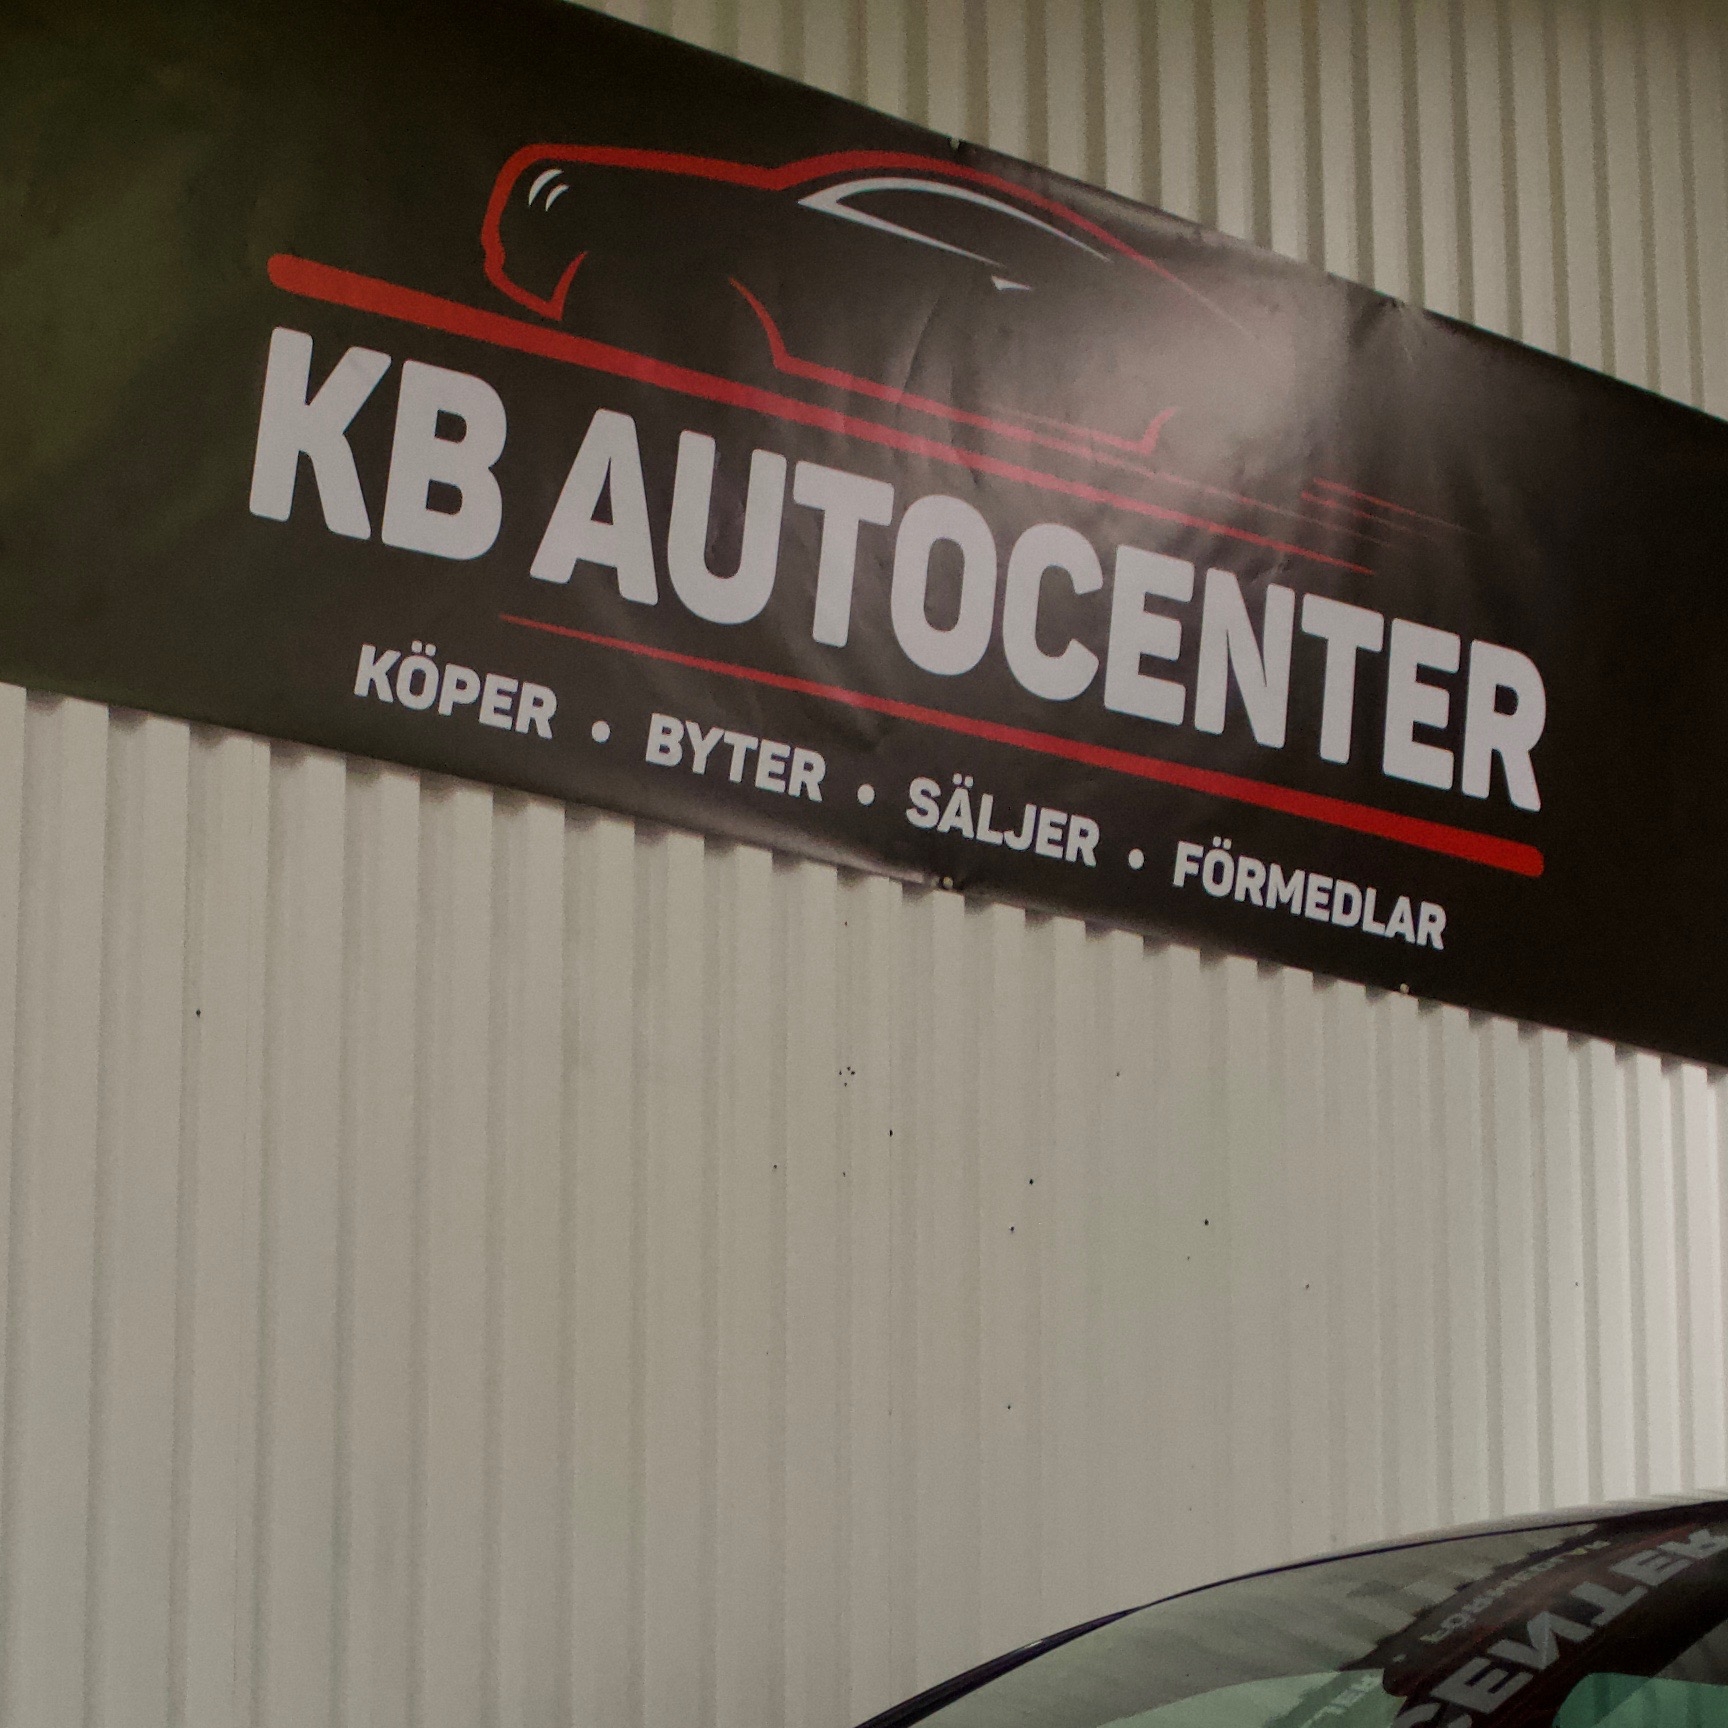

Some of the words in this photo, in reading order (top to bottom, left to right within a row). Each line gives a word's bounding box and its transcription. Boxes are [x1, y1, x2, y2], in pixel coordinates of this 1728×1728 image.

[248, 325, 508, 562] KB
[528, 407, 1547, 813] AUTOCENTER
[353, 640, 558, 740] KÖPER
[645, 712, 827, 803] BYTER
[905, 772, 1100, 867] SÄLJER
[1172, 838, 1447, 950] FÖRMEDLAR
